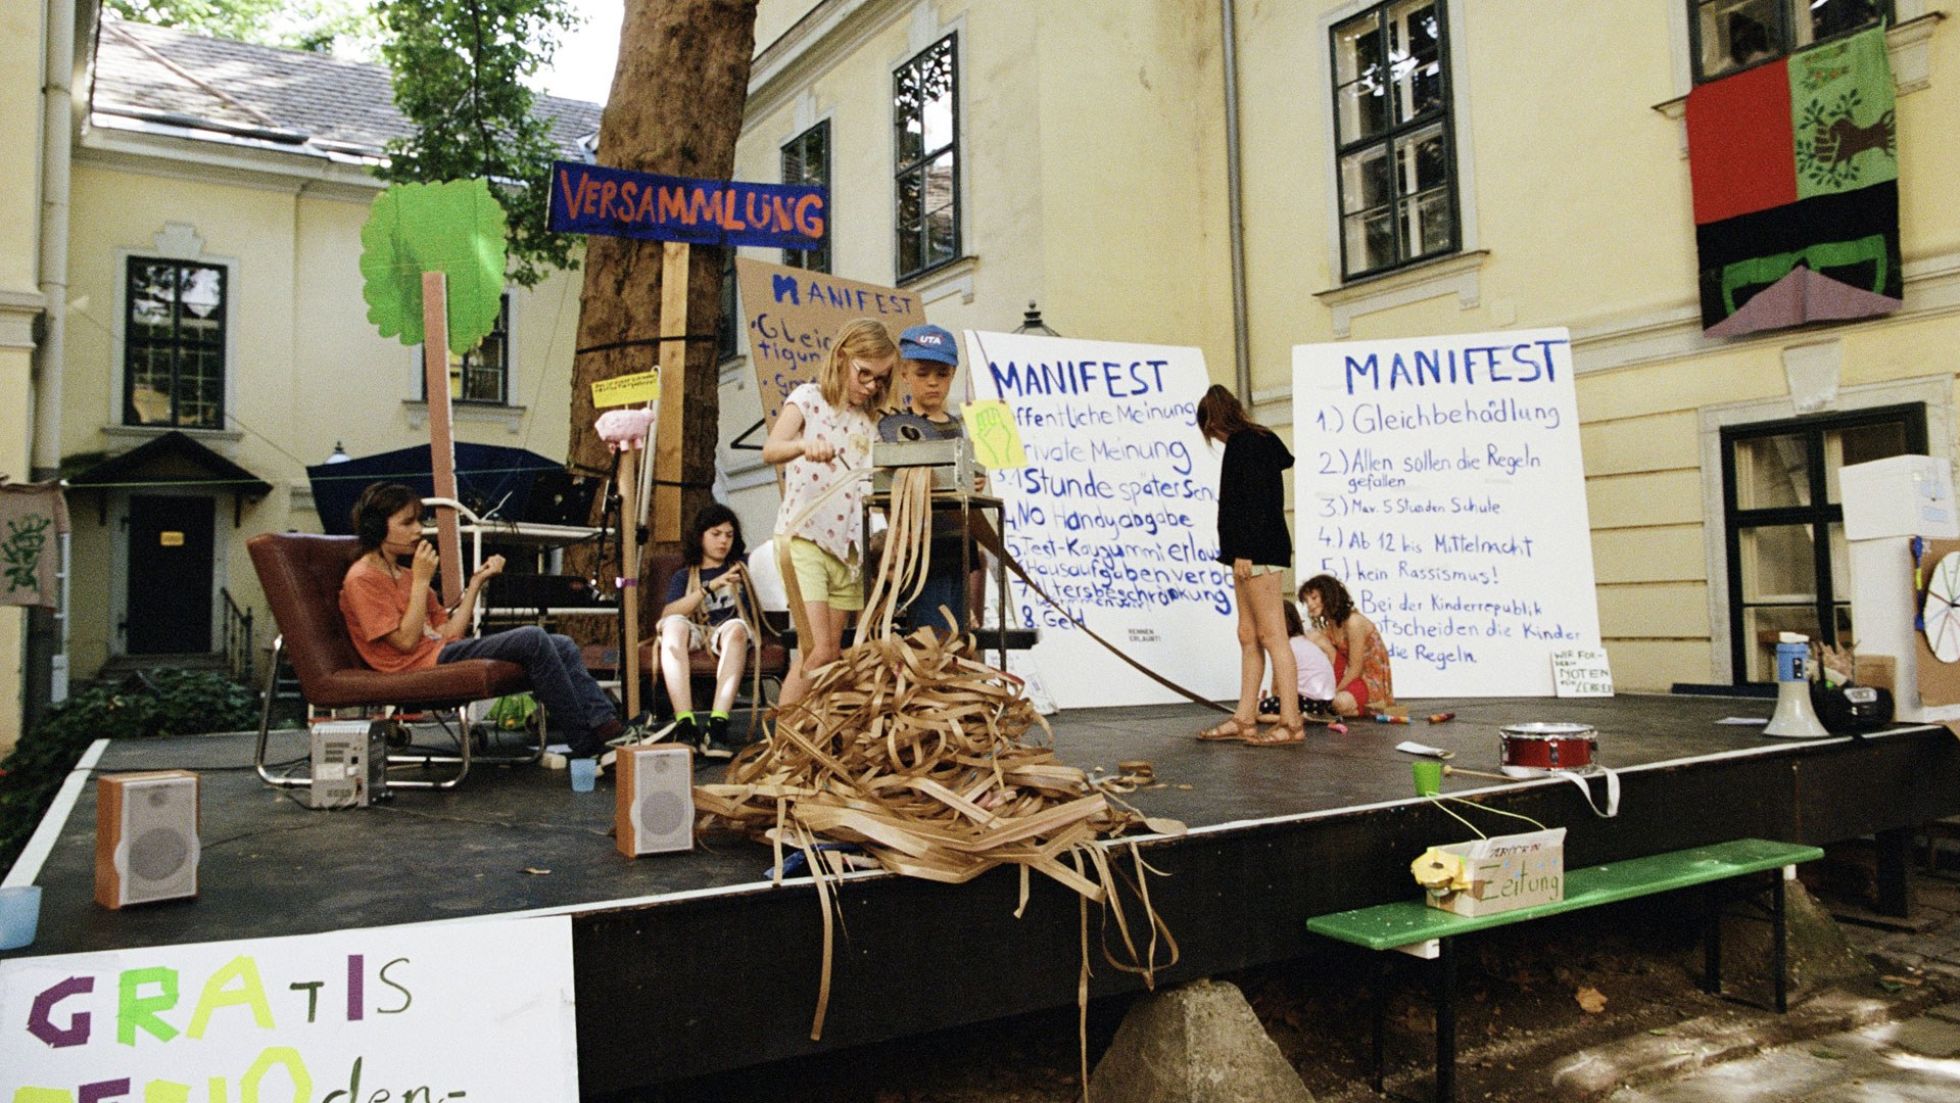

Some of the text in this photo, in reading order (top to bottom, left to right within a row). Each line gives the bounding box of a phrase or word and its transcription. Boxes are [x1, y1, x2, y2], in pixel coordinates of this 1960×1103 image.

[559, 169, 824, 239] VERSAMMLUNG
[772, 273, 913, 315] MANIFEST
[758, 340, 822, 370] tigun
[919, 335, 942, 345] UTA
[990, 360, 1168, 399] MANIFEST
[1345, 340, 1569, 395] MANIFEST
[1013, 401, 1197, 430] ffentliche Meinung
[1023, 436, 1193, 476] rivate Meinung
[1351, 447, 1393, 473] Allen
[1403, 447, 1452, 472] sollen
[1456, 447, 1481, 470] die
[1487, 442, 1541, 475] Regeln
[1024, 467, 1115, 499] Stunde
[1347, 473, 1406, 494] gefallen
[1451, 495, 1501, 515] Schule
[1348, 531, 1370, 550] Ab
[1379, 531, 1396, 552] 12
[1360, 589, 1542, 617] Bei der Kinderrepublik
[1486, 618, 1512, 637] die
[1522, 622, 1580, 640] Kinder
[27, 953, 413, 1049] GRATIS
